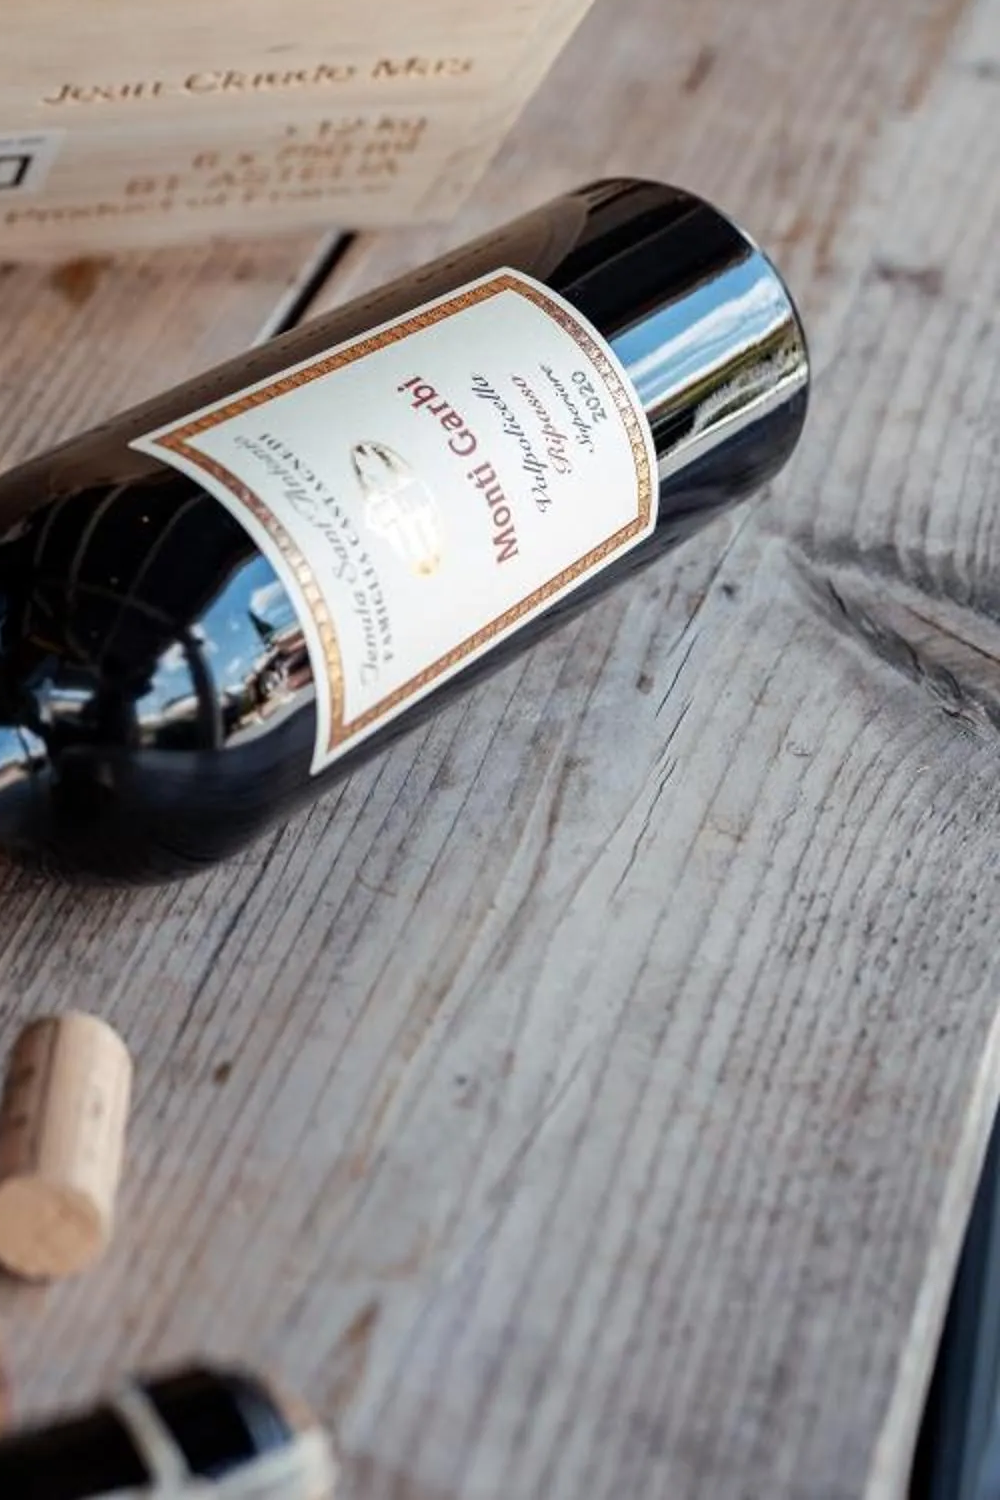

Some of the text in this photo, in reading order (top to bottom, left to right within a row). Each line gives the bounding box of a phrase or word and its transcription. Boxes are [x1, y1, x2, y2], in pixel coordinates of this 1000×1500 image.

[470, 370, 555, 515] Valpolicella
[510, 373, 572, 476] Ripasso
[538, 361, 597, 454] Superiore
[571, 369, 608, 423] 2020
[397, 374, 520, 565] Monti Garbi
